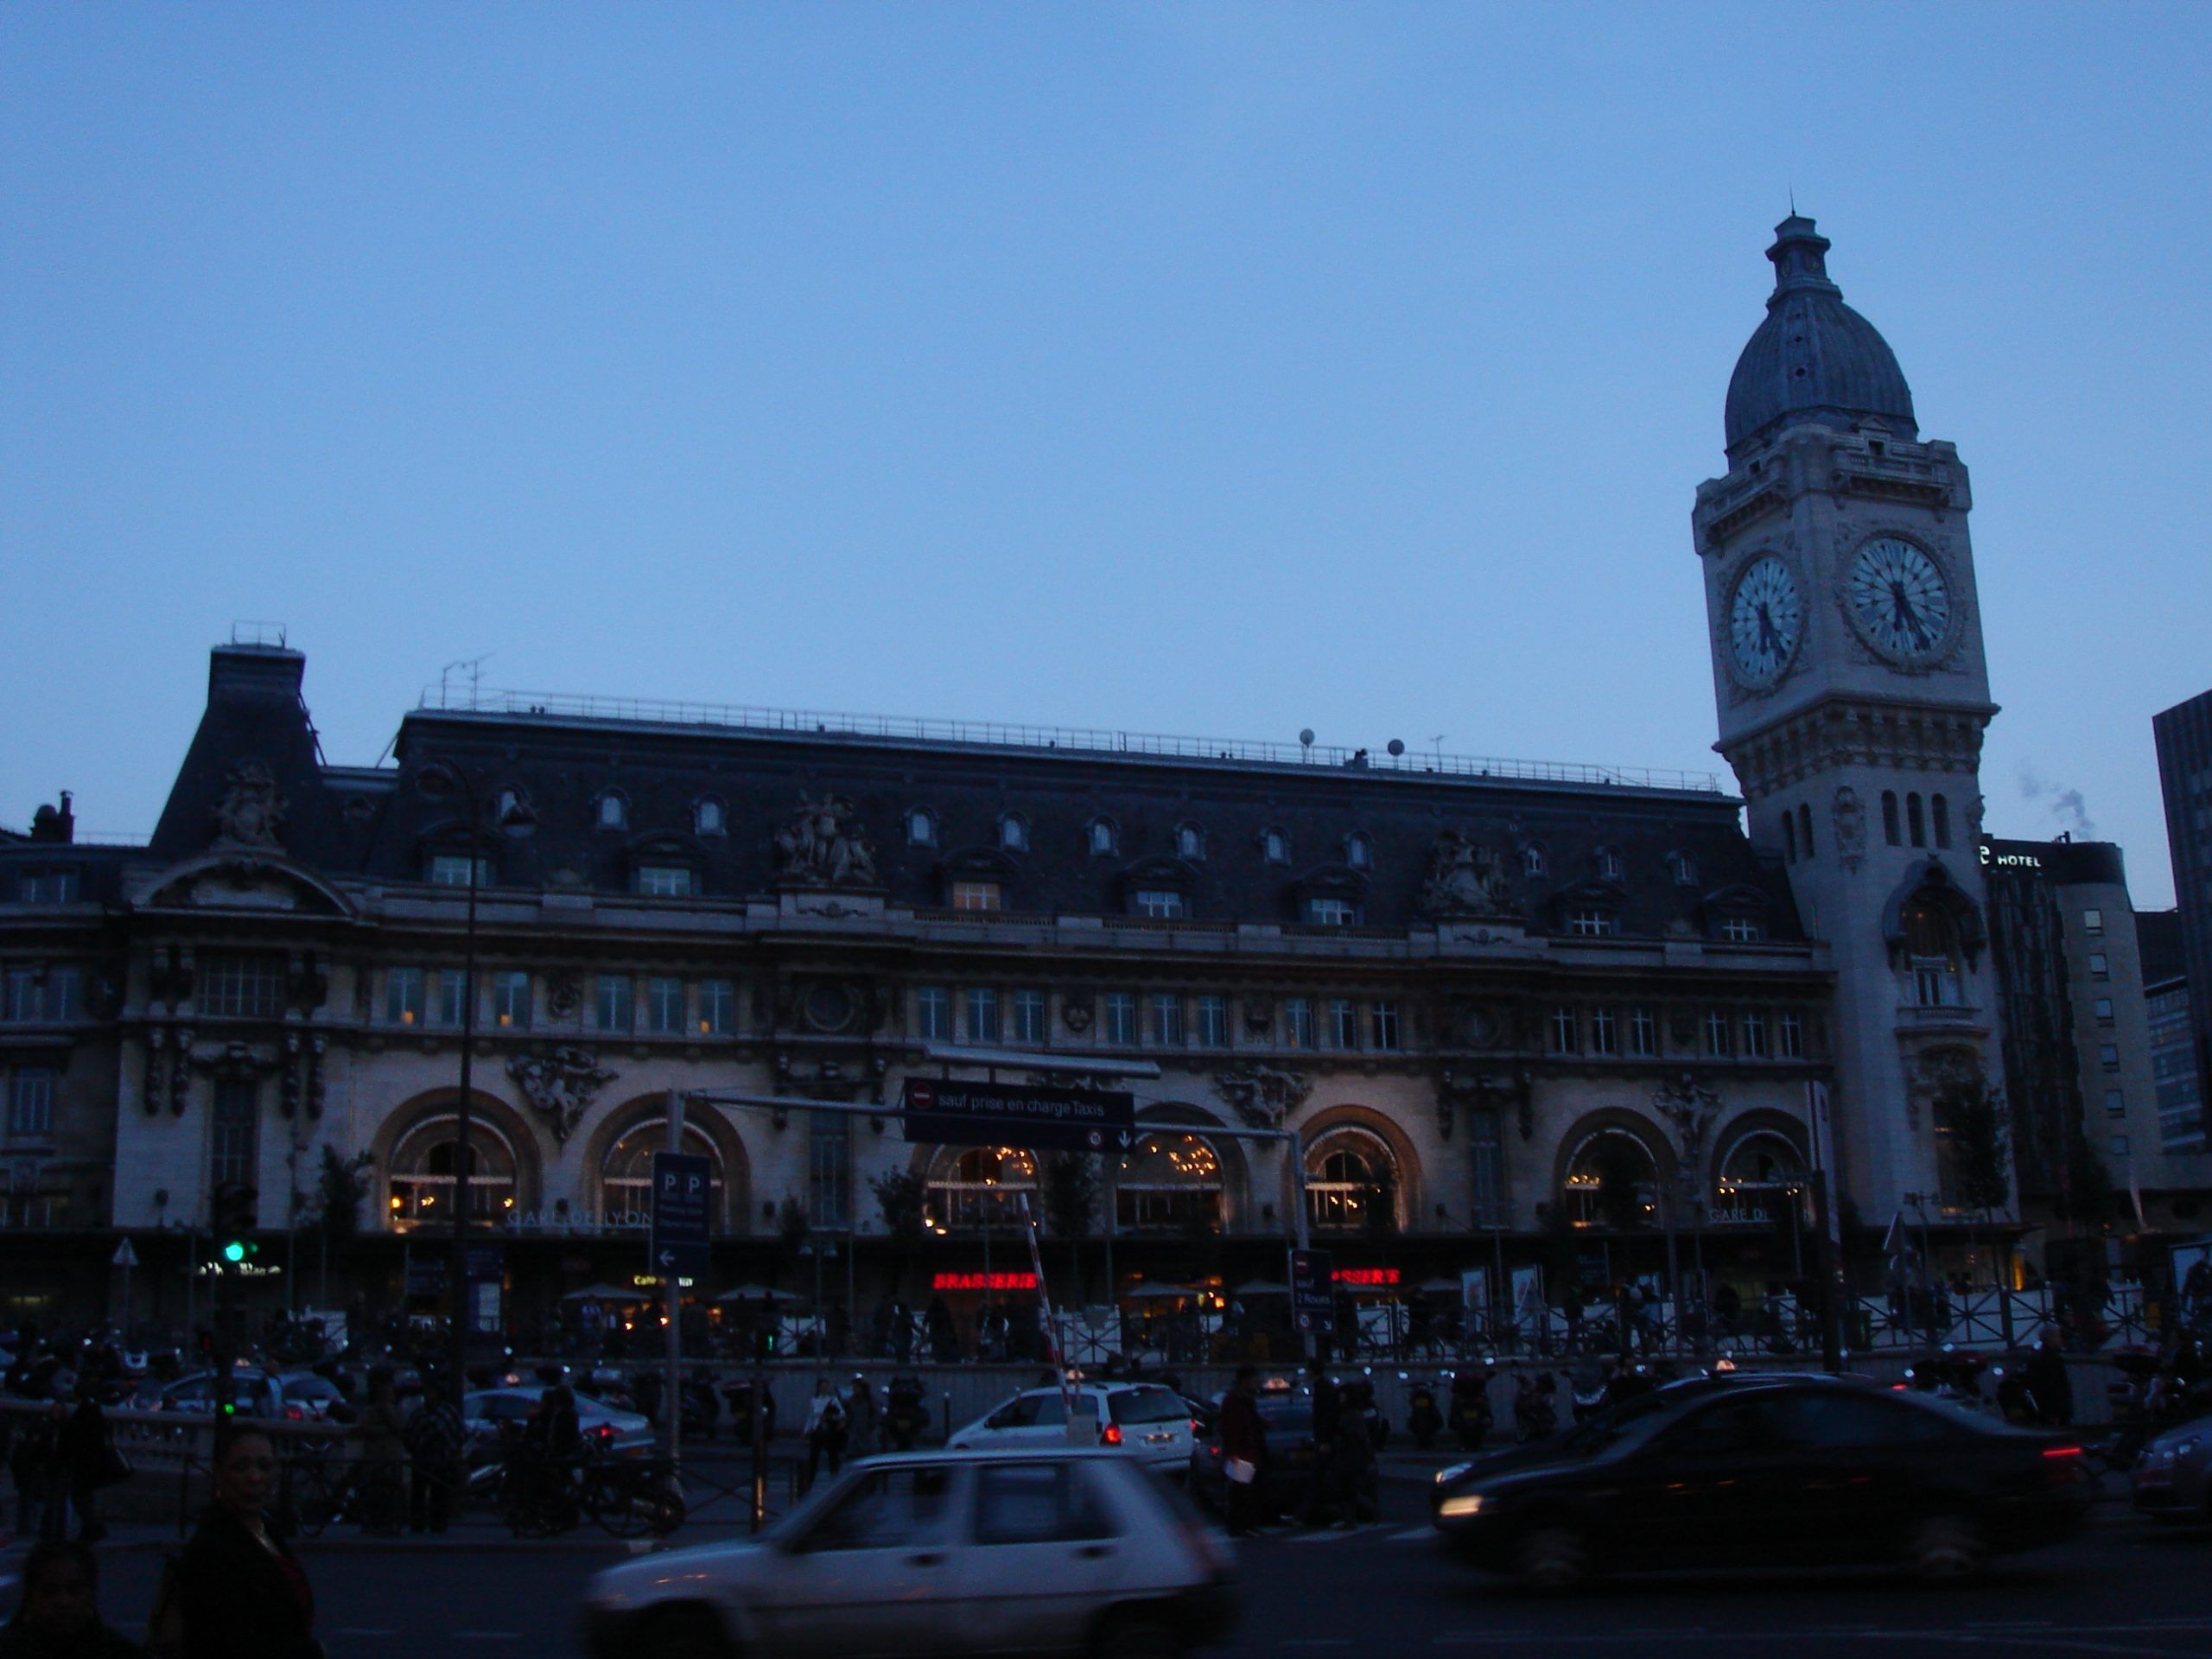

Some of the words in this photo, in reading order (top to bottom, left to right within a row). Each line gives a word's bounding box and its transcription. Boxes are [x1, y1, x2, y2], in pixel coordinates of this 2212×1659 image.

[1997, 855, 2041, 867] HOTEL
[938, 1093, 968, 1109] sauf
[971, 1095, 1004, 1112] prise
[1007, 1100, 1024, 1111] en
[1027, 1098, 1070, 1117] charge
[1072, 1100, 1105, 1116] Taxis
[664, 1173, 677, 1191] P
[688, 1175, 701, 1194] P
[605, 1211, 652, 1226] LYON
[1709, 1208, 1747, 1221] GARE
[933, 1273, 1037, 1289] BRASSERIE
